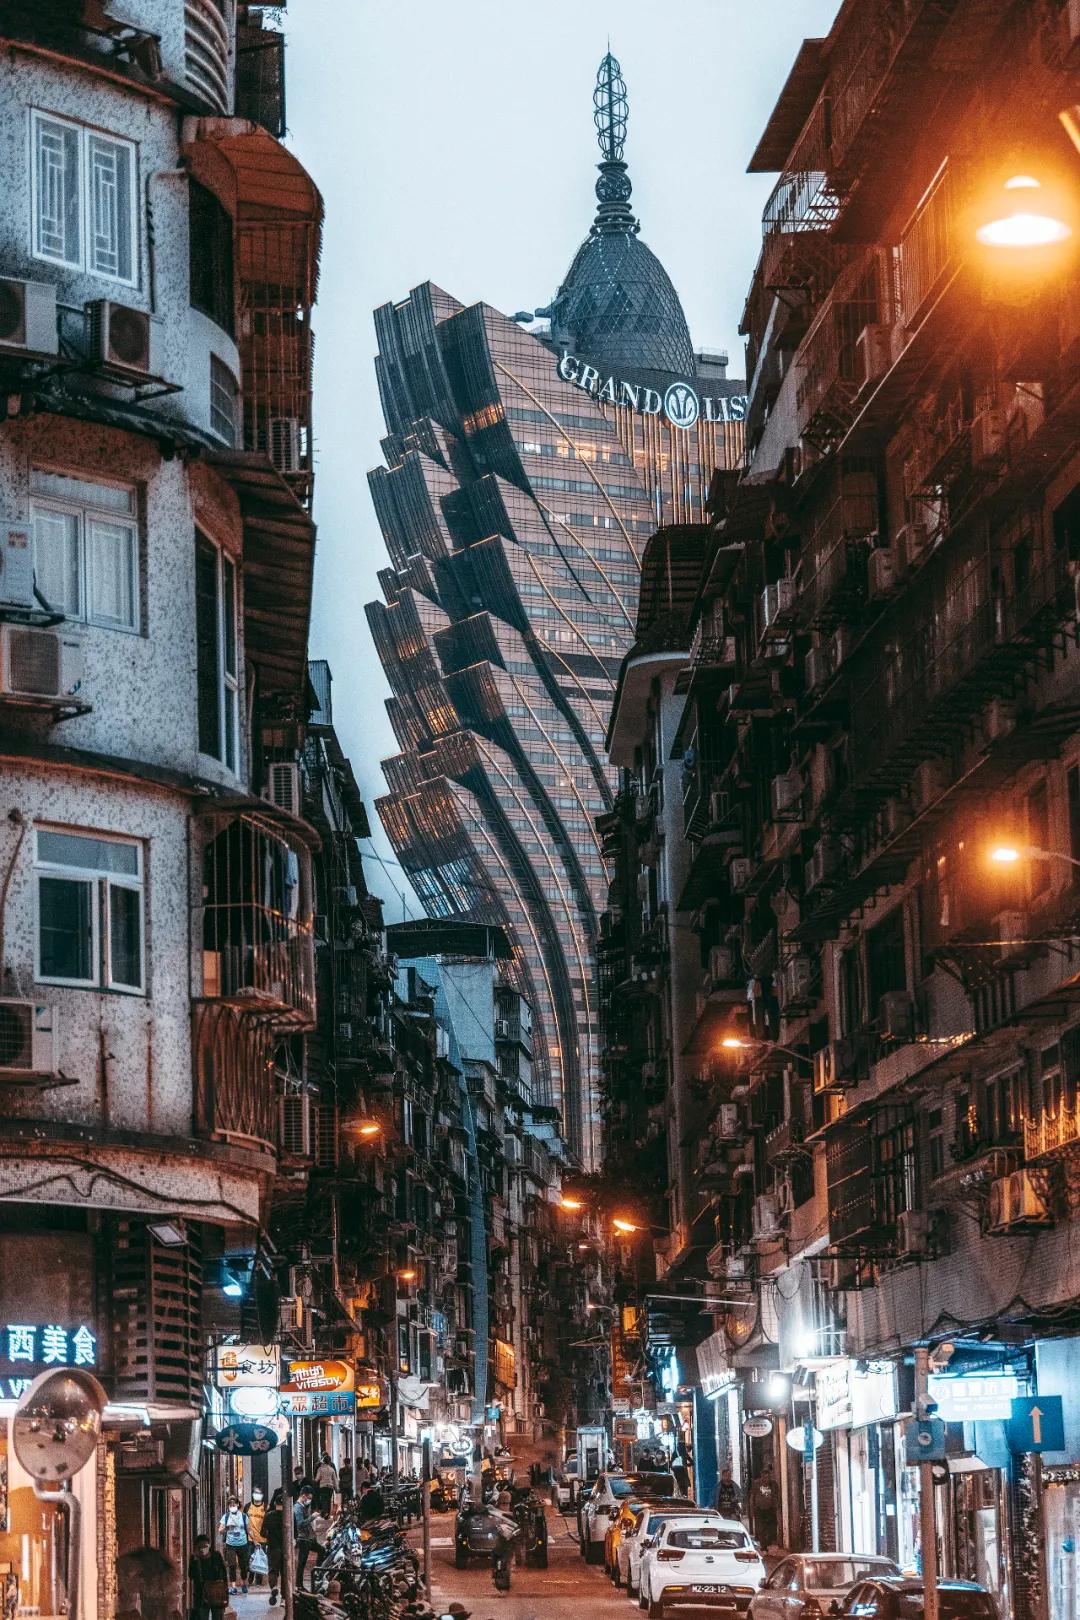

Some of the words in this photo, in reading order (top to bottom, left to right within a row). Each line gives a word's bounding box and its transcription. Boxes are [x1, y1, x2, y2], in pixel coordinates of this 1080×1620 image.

[559, 355, 662, 414] GRAND
[703, 395, 748, 421] LIS
[7, 1324, 97, 1365] 西美食
[238, 1359, 276, 1375] 食坊
[296, 1375, 340, 1390] vitasoy
